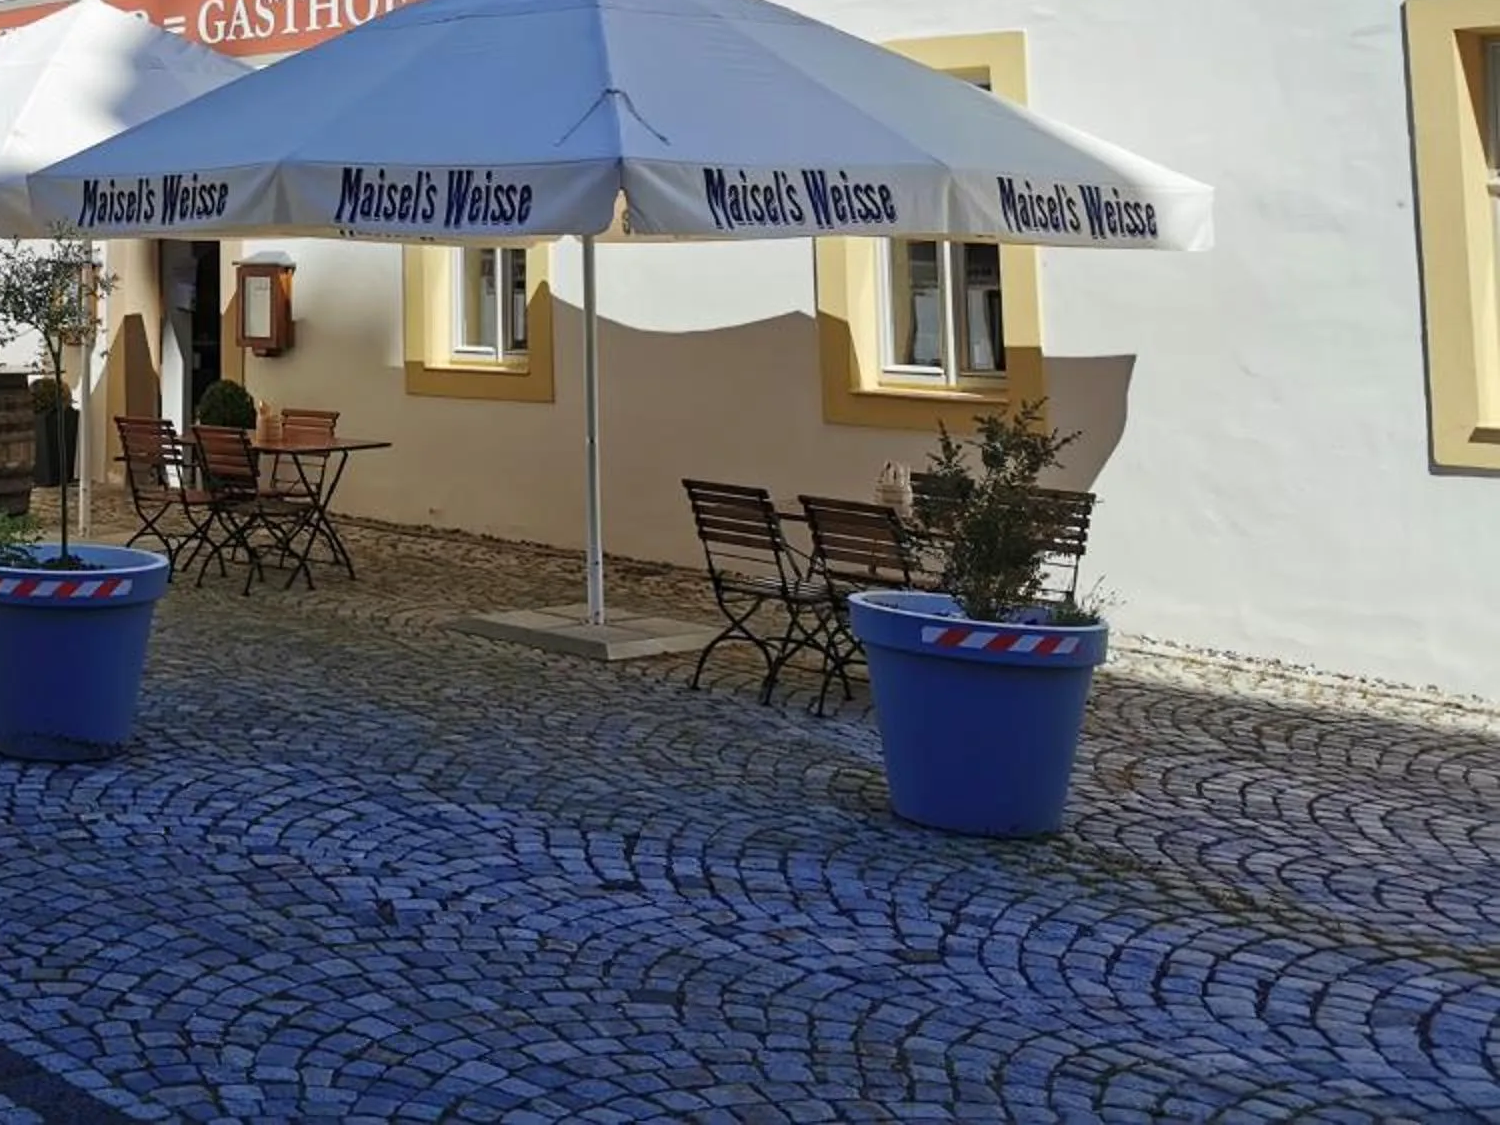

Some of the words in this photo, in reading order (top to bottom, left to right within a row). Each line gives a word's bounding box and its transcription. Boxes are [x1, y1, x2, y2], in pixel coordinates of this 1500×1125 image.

[77, 178, 156, 227] Maisel's
[160, 173, 229, 226] Weisse
[334, 166, 438, 224] Maisel's
[443, 169, 534, 229] Weisse
[702, 167, 806, 231] Maisel's
[800, 169, 899, 230] Weisse
[996, 176, 1083, 235] Maisel's
[1077, 184, 1160, 241] Weisse
